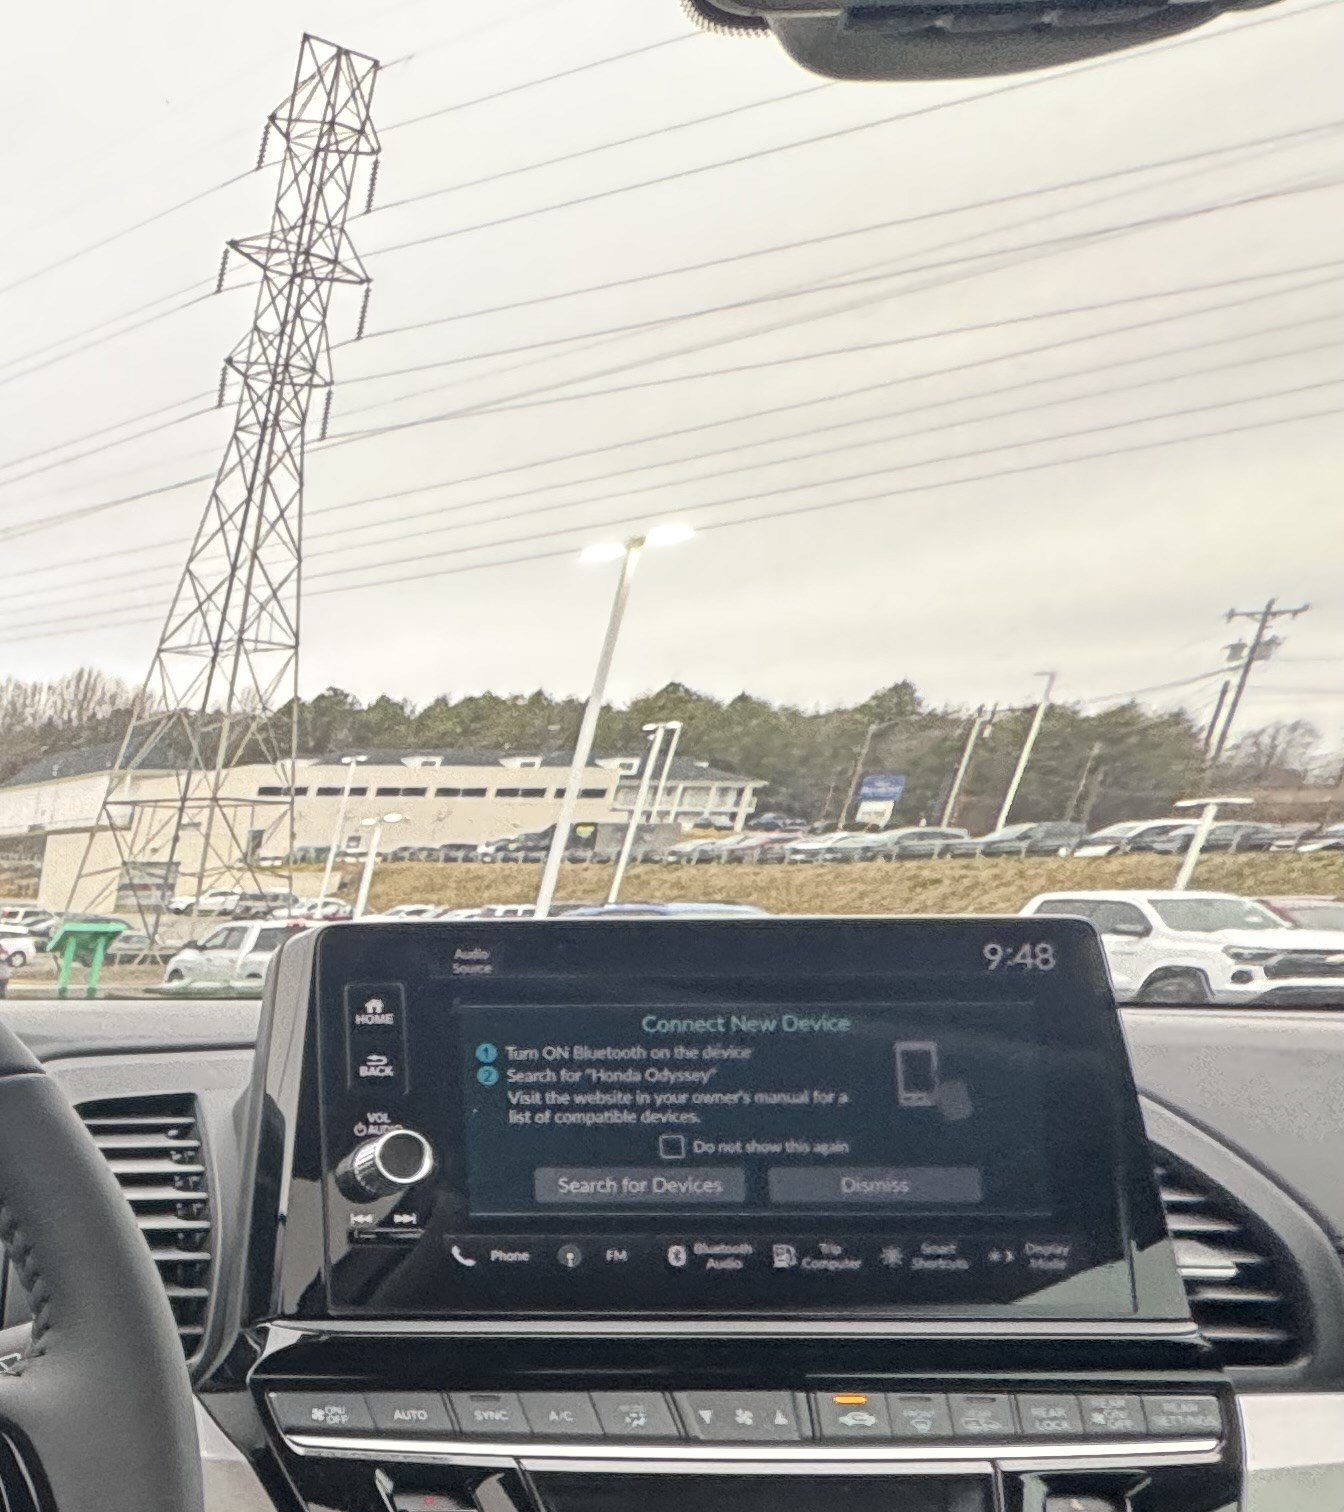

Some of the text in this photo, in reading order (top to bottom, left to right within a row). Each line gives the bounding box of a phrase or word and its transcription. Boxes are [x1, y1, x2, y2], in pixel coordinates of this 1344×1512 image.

[453, 948, 490, 960] Audio
[982, 942, 1055, 971] 9:48
[355, 1013, 394, 1025] HOME
[641, 1014, 852, 1033] Connect New Device
[505, 1045, 539, 1060] Turn
[542, 1045, 570, 1060] ON
[573, 1045, 647, 1060] Bluetooth
[650, 1048, 670, 1059] on
[673, 1045, 699, 1059] the
[702, 1045, 752, 1059] device
[359, 1065, 394, 1077] BACK
[506, 1068, 557, 1083] Search
[561, 1068, 582, 1083] for
[508, 1090, 850, 1107] Visit the website in your owner's manual for a
[367, 1112, 391, 1123] VOL
[508, 1110, 531, 1124] list
[534, 1110, 552, 1124] of
[554, 1110, 637, 1127] compatible
[693, 1140, 849, 1156] Do not show this again
[558, 1176, 723, 1194] Search for Devices
[841, 1176, 909, 1194] Dismiss
[490, 1250, 531, 1262] Phone
[606, 1250, 629, 1262] FM
[706, 1258, 743, 1270] Audio
[393, 1409, 428, 1421] AUTO
[473, 1410, 509, 1421] SYNC
[548, 1411, 575, 1422] A/C
